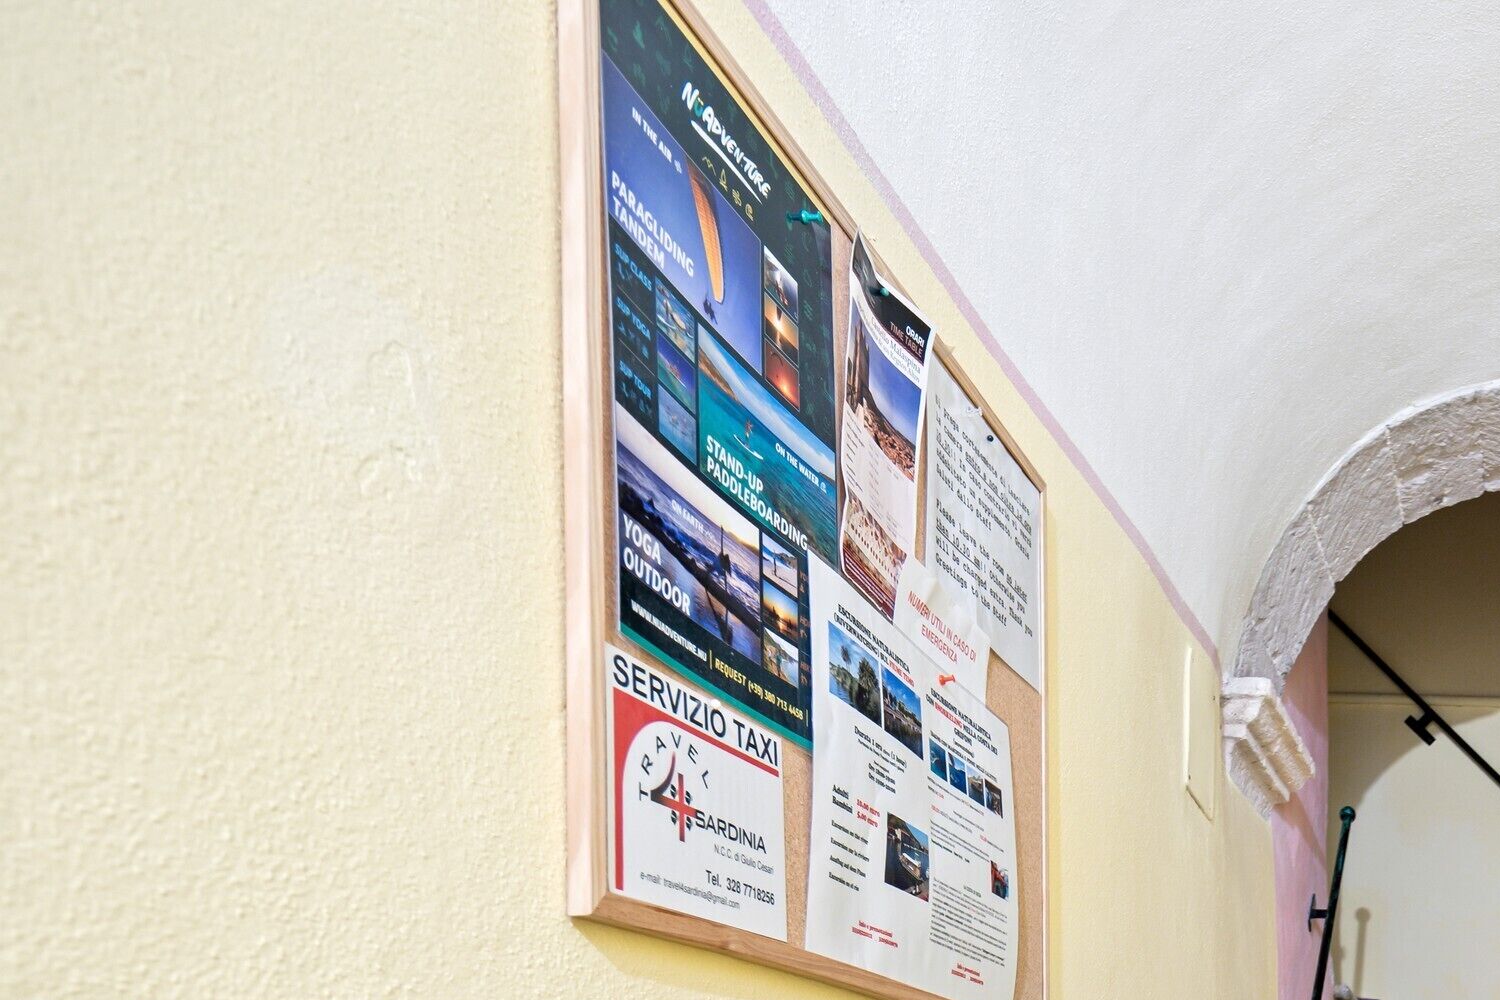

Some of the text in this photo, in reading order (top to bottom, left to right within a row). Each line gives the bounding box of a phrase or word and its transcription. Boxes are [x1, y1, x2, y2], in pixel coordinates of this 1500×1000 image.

[632, 107, 672, 163] IN THE AIR
[612, 170, 694, 278] PARAGLIDING
[613, 195, 665, 270] TANDEM
[630, 263, 653, 292] CLASS
[631, 312, 652, 341] YOGA
[890, 321, 923, 358] TIME TABLE
[905, 325, 925, 348] ORARI
[633, 374, 652, 400] TOUR
[706, 435, 764, 495] STAND-UP
[775, 442, 820, 487] ON THE WATER
[943, 407, 959, 434] prega
[1007, 485, 1029, 516] lasciare
[943, 425, 962, 452] camera
[965, 449, 981, 474] entro
[988, 478, 997, 494] non
[1000, 490, 1014, 512] oltre
[706, 455, 809, 551] PADDLEBOARDING
[935, 464, 991, 531] Saluti dallo Staff
[968, 470, 981, 490] caso
[983, 486, 1009, 522] contrario
[622, 513, 662, 565] YOGA
[935, 498, 955, 526] Please
[958, 523, 976, 547] leave
[979, 543, 989, 560] the
[992, 558, 1004, 576] room
[1014, 581, 1027, 599] later
[935, 516, 948, 537] than
[952, 534, 970, 558] 10.30
[988, 570, 1014, 602] Otherwise
[1016, 600, 1025, 616] you
[1014, 536, 1029, 559] Grazie
[623, 546, 692, 616] OUTDOOR
[935, 535, 949, 554] will
[962, 560, 986, 591] charged
[1008, 606, 1022, 626] Thank
[1024, 623, 1032, 639] you
[935, 553, 967, 590] Greetings
[980, 593, 990, 609] the
[992, 605, 1007, 626] Staff
[837, 603, 873, 641] ESCURSIONE
[871, 632, 911, 675] NATURALISTICA
[907, 590, 977, 662] NUMERI UTILI IN CASO DI
[921, 624, 958, 664] EMERGENZA
[613, 653, 726, 738] SERVIZIO
[733, 718, 779, 767] TAXI
[714, 658, 747, 688] REQUEST
[748, 679, 763, 701] (+39)
[776, 693, 788, 711] 713
[854, 725, 872, 744] Durata
[638, 731, 711, 802] TRAVEL
[695, 810, 767, 854] SARDINIA
[713, 843, 734, 862] N.C.C.
[734, 851, 740, 863] di
[740, 852, 757, 869] Giulio
[705, 869, 722, 888] Tel.
[726, 876, 741, 894] 328
